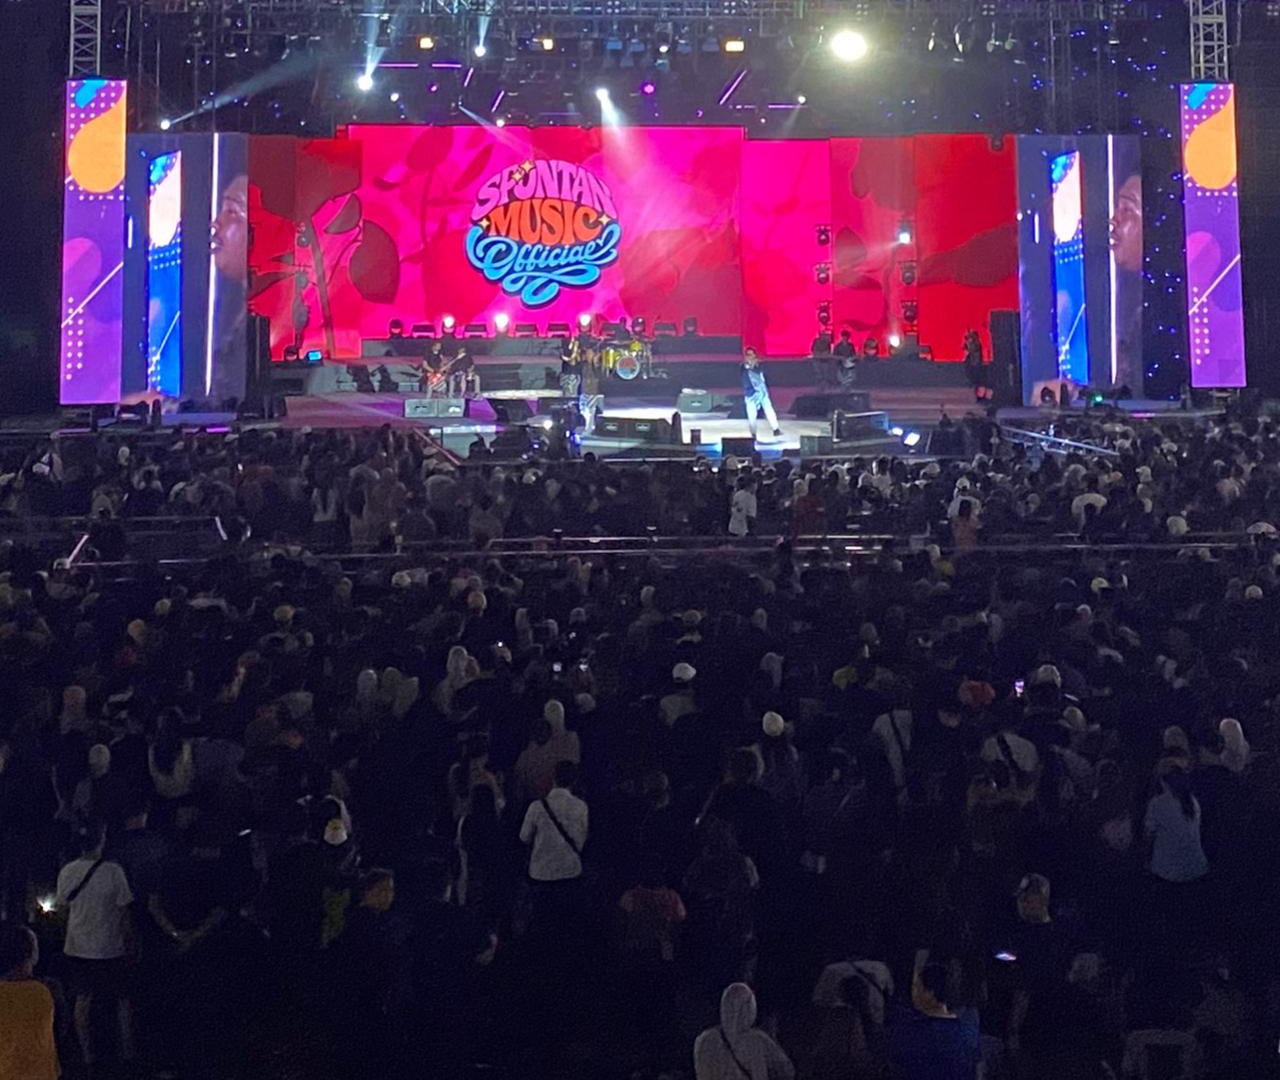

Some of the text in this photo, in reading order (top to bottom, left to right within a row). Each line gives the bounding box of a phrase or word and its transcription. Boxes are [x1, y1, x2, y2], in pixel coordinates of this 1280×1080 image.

[471, 160, 618, 221] SPONTAN
[487, 198, 603, 245] MUSIC
[466, 223, 621, 295] Official
